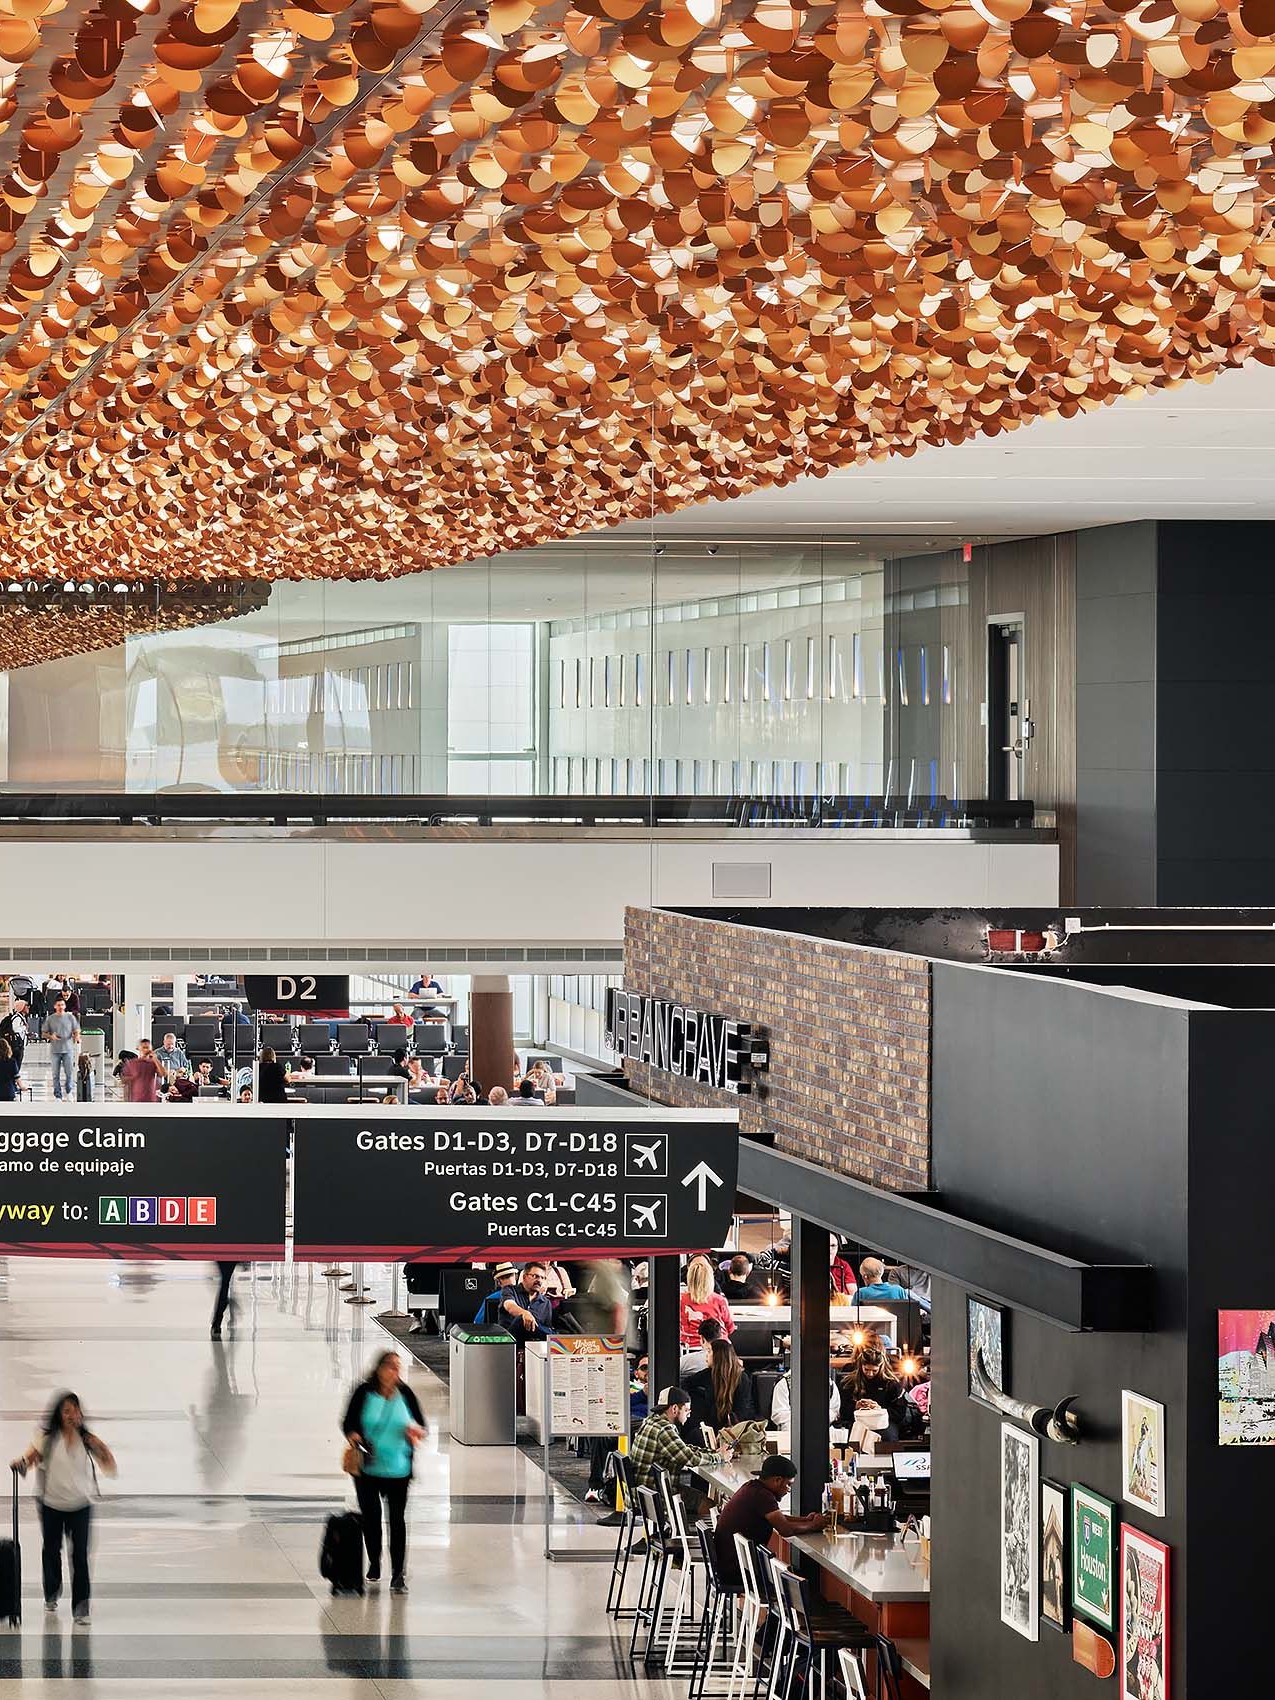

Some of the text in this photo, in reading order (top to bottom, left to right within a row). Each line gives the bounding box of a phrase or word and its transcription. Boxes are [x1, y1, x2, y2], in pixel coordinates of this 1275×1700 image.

[276, 975, 317, 1000] D2
[78, 1127, 146, 1148] Claim
[356, 1130, 618, 1155] Gates D1-D3, D7-D18
[39, 1157, 60, 1173] de
[64, 1158, 135, 1177] equipaje
[424, 1161, 618, 1179] Puertas D1-D3, D7-D18
[61, 1201, 89, 1221] to:
[105, 1199, 121, 1222] A
[135, 1199, 151, 1222] B
[165, 1199, 180, 1222] D
[449, 1191, 618, 1213] Gates C1-C45
[487, 1222, 618, 1237] Puertas C1-C45
[1080, 1545, 1106, 1582] Houston
